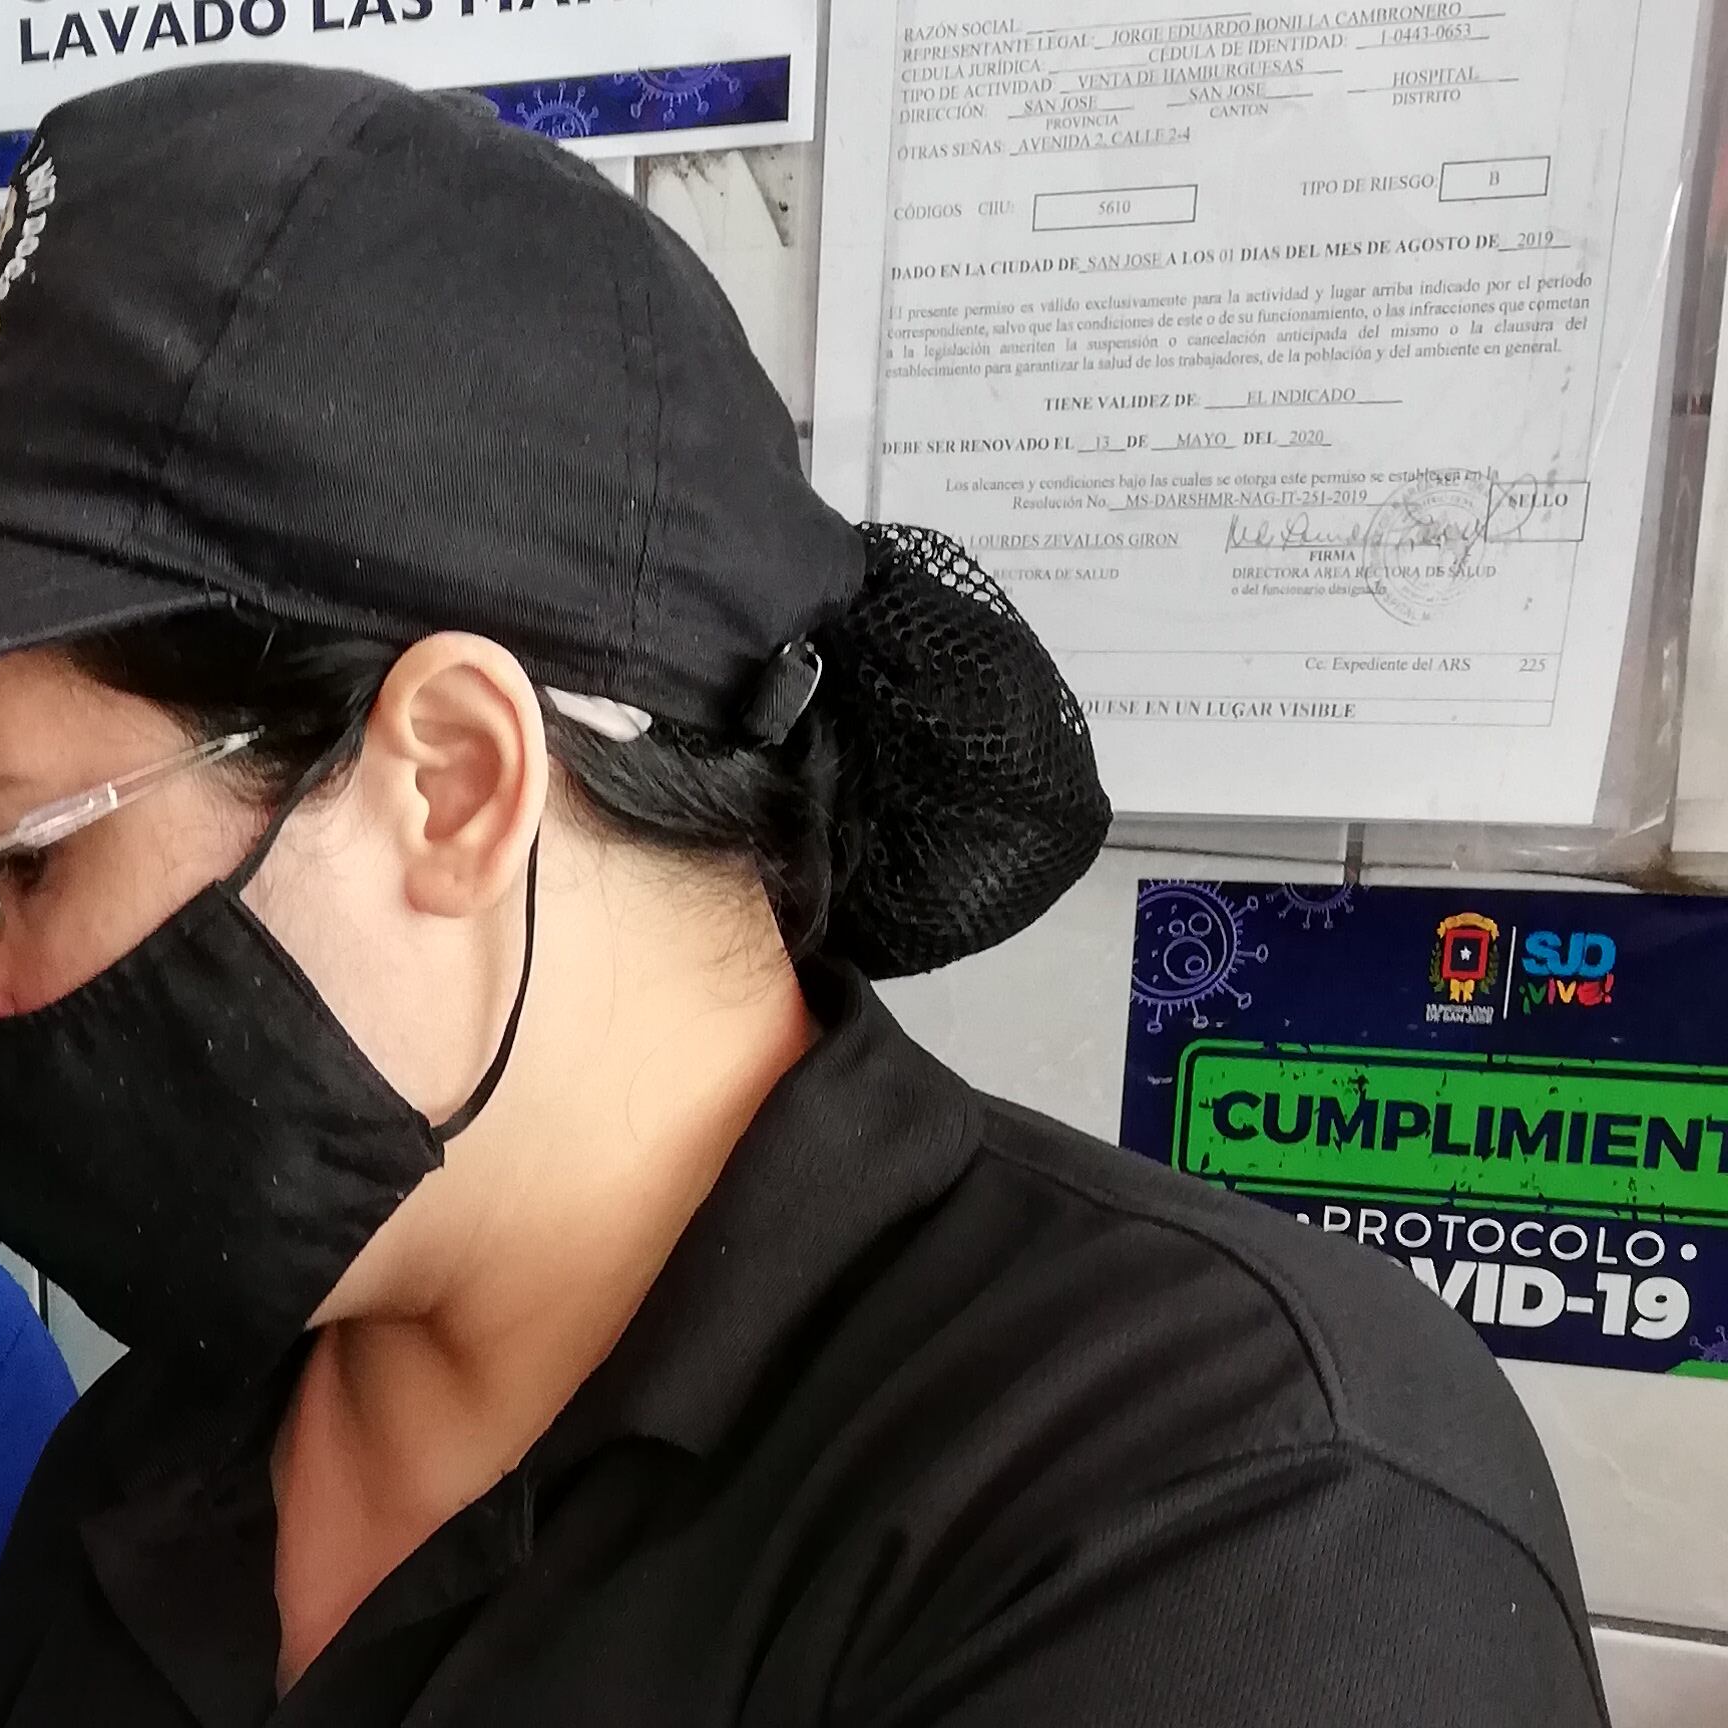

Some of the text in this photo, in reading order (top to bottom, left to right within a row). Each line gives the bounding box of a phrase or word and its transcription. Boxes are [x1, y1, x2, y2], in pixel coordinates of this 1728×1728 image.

[20, 0, 285, 64] LAVADO
[902, 36, 1029, 63] REPRESENTANTE
[1111, 26, 1160, 45] JORGE
[1168, 19, 1250, 40] EDUARDO
[1255, 12, 1329, 33] BONILLA
[1335, 2, 1461, 26] CAMBRONERO
[904, 22, 956, 43] RAZÓN
[1222, 41, 1242, 57] DE
[901, 58, 1304, 104] TIPO DE VENTA HAMBURGUESAS
[1023, 98, 1055, 114] SAN
[1060, 96, 1097, 112] JOSE
[1190, 85, 1221, 102] SAN
[1225, 82, 1265, 99] JOSE
[1392, 87, 1461, 106] DISTRITO
[1045, 112, 1119, 131] PROVINCIA
[1210, 102, 1269, 119] CANTON
[897, 144, 947, 162] OTRAS
[1019, 133, 1090, 152] AVENIDA
[1300, 177, 1365, 196] TIPO DE
[1098, 199, 1131, 216] 5610
[891, 263, 935, 281] DADO
[940, 262, 960, 278] EN
[991, 256, 1053, 275] CIUDAD
[1058, 255, 1080, 272] DE
[1087, 254, 1120, 271] SAN
[1182, 248, 1214, 265] LOS
[1240, 244, 1280, 262] DIAS
[1286, 242, 1320, 259] DEL
[1325, 240, 1362, 257] MES
[1367, 239, 1390, 255] DE
[1395, 234, 1471, 254] AGOSTO
[1476, 233, 1499, 250] DE
[1517, 230, 1554, 248] 2019
[908, 303, 959, 323] presente
[964, 301, 1015, 320] permiso
[1085, 293, 1186, 311] exclusivamente
[1193, 293, 1223, 309] para
[1245, 285, 1309, 303] actividad
[1330, 284, 1365, 303] lugar
[1372, 281, 1413, 298] arriba
[1420, 278, 1479, 296] indicado
[1487, 281, 1511, 297] por
[1029, 322, 1052, 338] que
[1077, 315, 1154, 331] condiciones
[1158, 313, 1173, 328] de
[1219, 310, 1234, 325] de
[1258, 305, 1368, 323] funcionamiento,
[1409, 301, 1494, 316] infracciones
[1499, 301, 1525, 317] que
[1087, 333, 1158, 354] suspensión
[1187, 328, 1265, 347] cancelación
[1276, 325, 1347, 345] anticipada
[1359, 324, 1379, 340] del
[1391, 324, 1439, 338] mismo
[1495, 318, 1553, 334] clausura
[1565, 316, 1588, 332] del
[885, 362, 981, 378] establecimiento
[985, 363, 1011, 379] para
[1015, 358, 1078, 378] garantizar
[1098, 354, 1132, 370] salud
[1136, 354, 1151, 369] de
[1155, 353, 1174, 368] los
[1267, 349, 1284, 364] de
[1305, 346, 1371, 367] población
[1389, 344, 1411, 360] del
[1415, 343, 1479, 359] ambiente
[1484, 345, 1501, 356] en
[1044, 386, 1355, 412] TIENE VALIDEZ EL INDICADO
[927, 438, 955, 454] SER
[960, 435, 1049, 453] RENOVADO
[1126, 432, 1149, 448] DE
[1177, 430, 1226, 447] MAYO
[1289, 428, 1323, 444] 2020
[946, 477, 968, 492] Los
[972, 476, 1024, 491] alcances
[1040, 475, 1114, 490] condiciones
[1119, 473, 1146, 492] bajo
[1150, 472, 1168, 487] las
[1172, 471, 1212, 487] cuales
[1234, 472, 1278, 489] otorga
[1281, 471, 1307, 484] este
[1311, 470, 1366, 488] permiso
[1012, 494, 1082, 510] Resolución
[1044, 533, 1123, 548] ZEVALLOS
[1128, 532, 1179, 547] GIRON
[1309, 549, 1356, 562] FIRMA
[1076, 568, 1119, 580] SALUD
[1232, 567, 1310, 580] DIRECTORA
[1332, 657, 1546, 675] Expediente del ARS 225
[1146, 701, 1169, 716] EN
[1176, 701, 1199, 717] UN
[1279, 703, 1356, 719] VISIBLE
[1323, 1204, 1666, 1268] PROTOCOLO
[1391, 1254, 1691, 1342] VID-19
